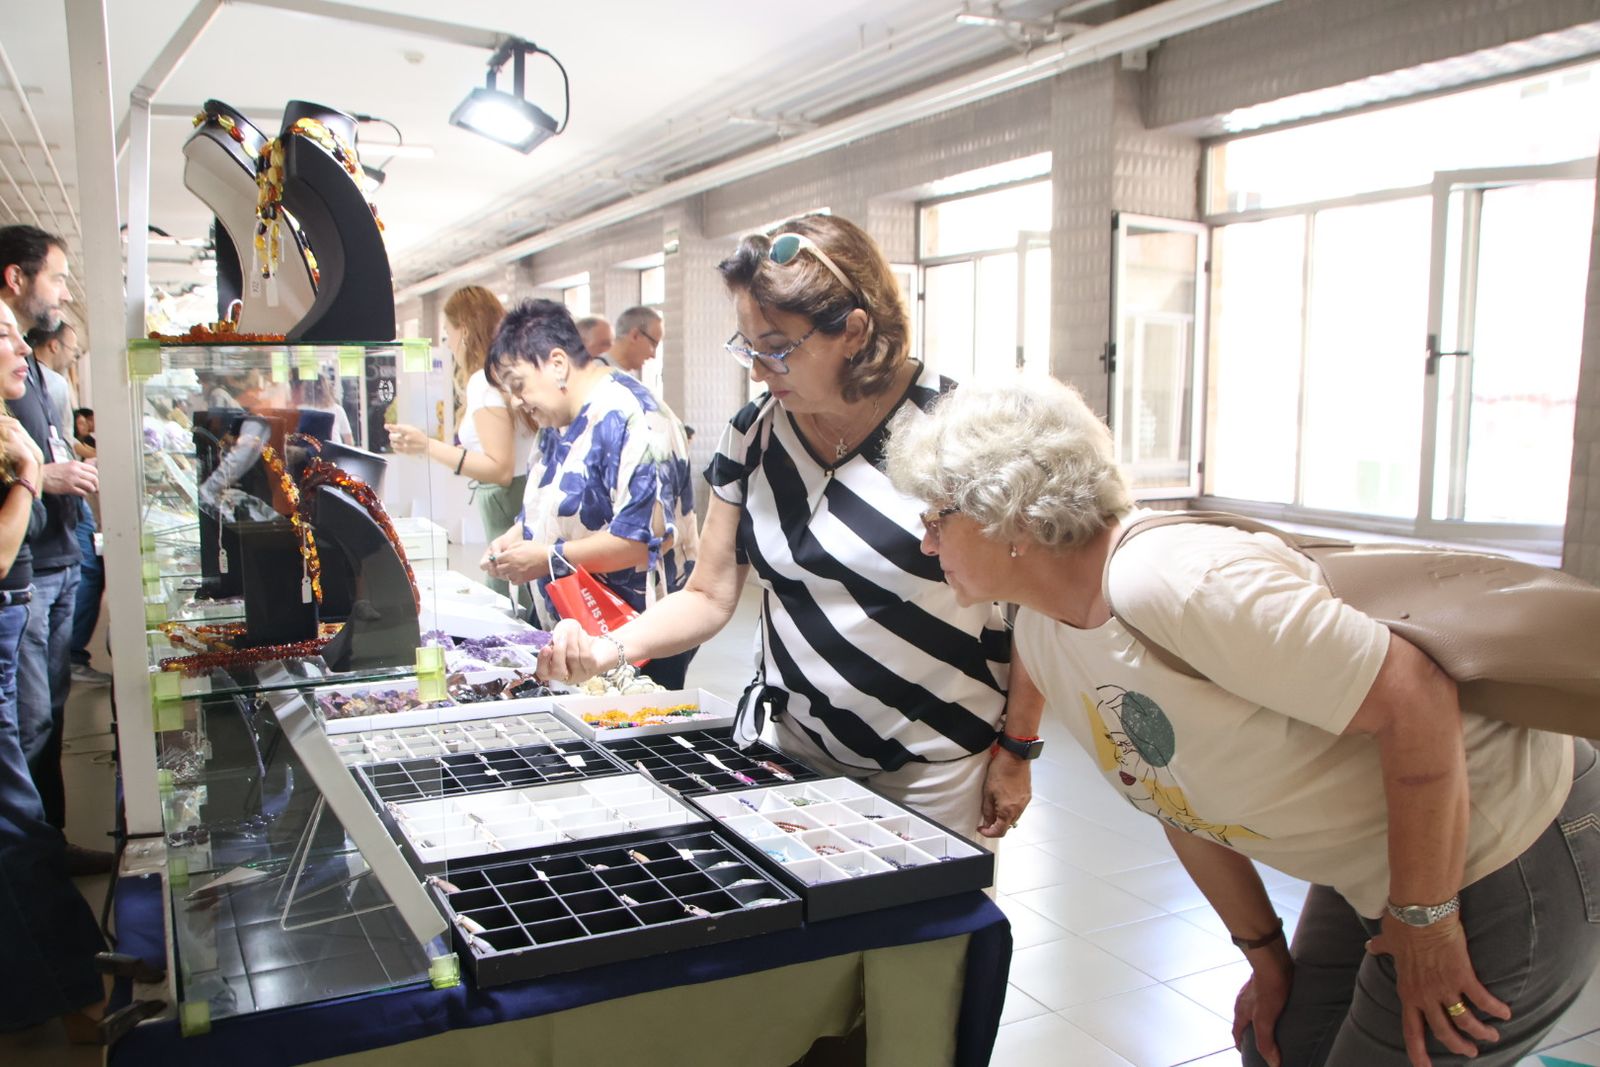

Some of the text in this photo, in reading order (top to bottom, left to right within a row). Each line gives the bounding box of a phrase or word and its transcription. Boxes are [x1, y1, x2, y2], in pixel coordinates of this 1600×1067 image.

[580, 588, 609, 633] LIFE IS FO
